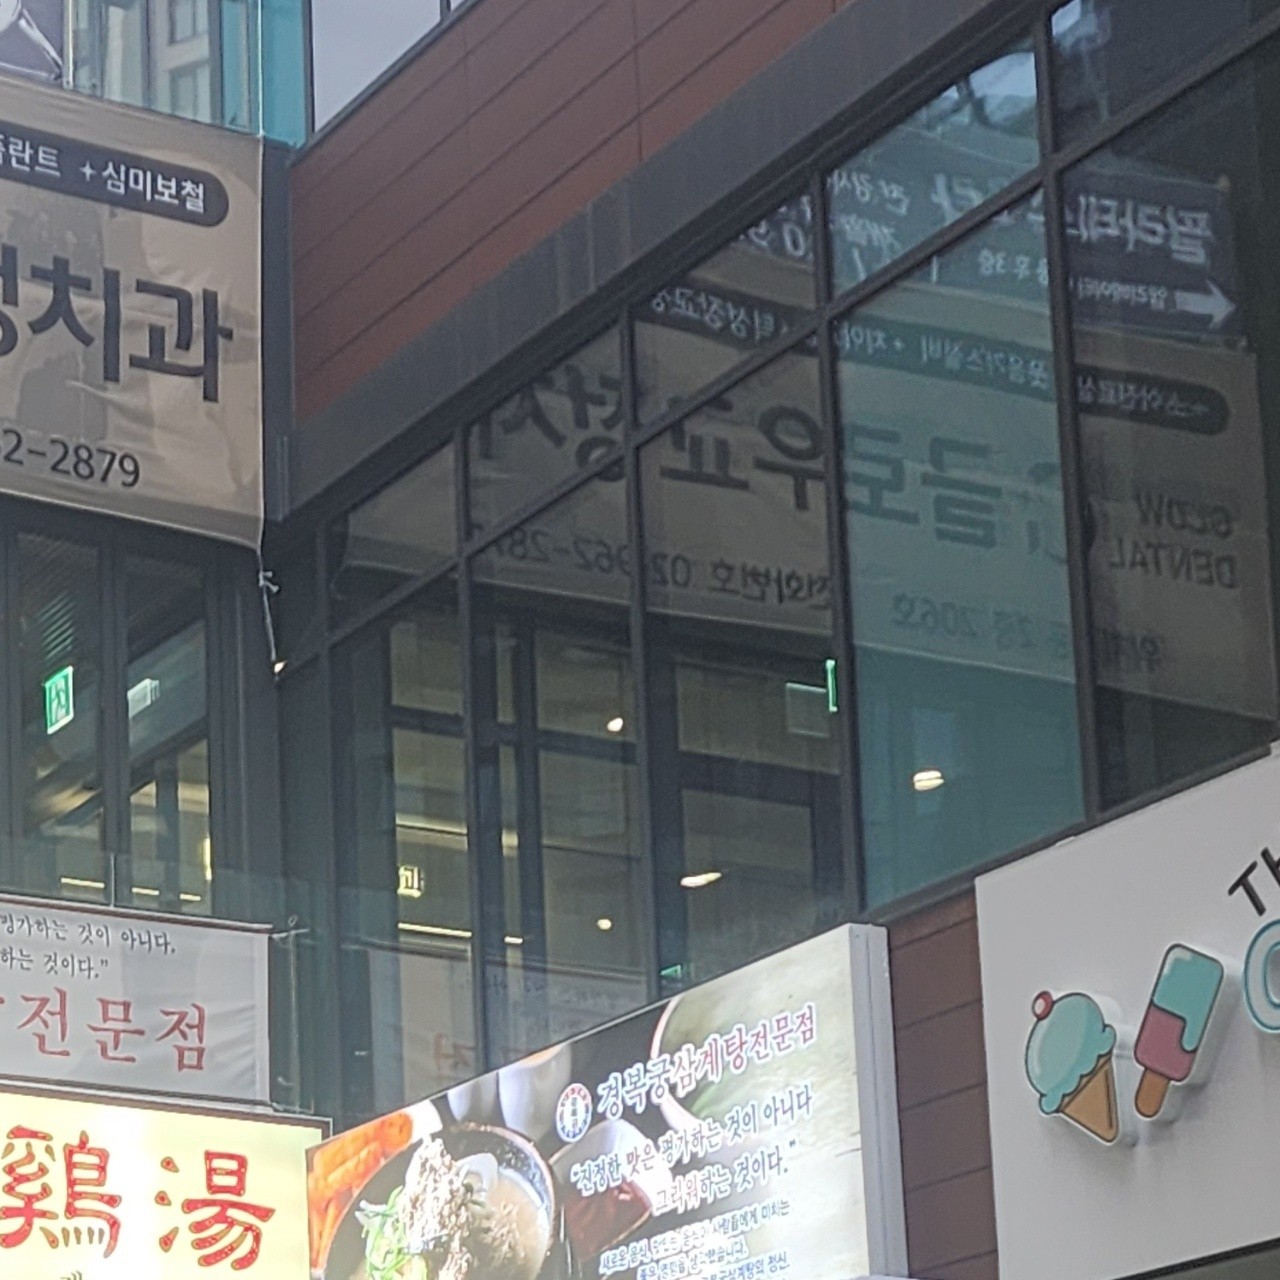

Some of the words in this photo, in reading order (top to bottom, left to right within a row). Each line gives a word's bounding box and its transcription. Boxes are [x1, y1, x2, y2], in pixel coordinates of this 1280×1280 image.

[101, 161, 205, 212] 심미보철
[78, 922, 111, 949] 것이
[120, 927, 177, 955] 아니다.
[597, 1003, 816, 1119] 경복궁삼계탕전문점
[627, 1144, 655, 1176] 맛은
[660, 1120, 721, 1165] 평가하는
[726, 1104, 758, 1143] 것이
[764, 1083, 813, 1127] 아니다
